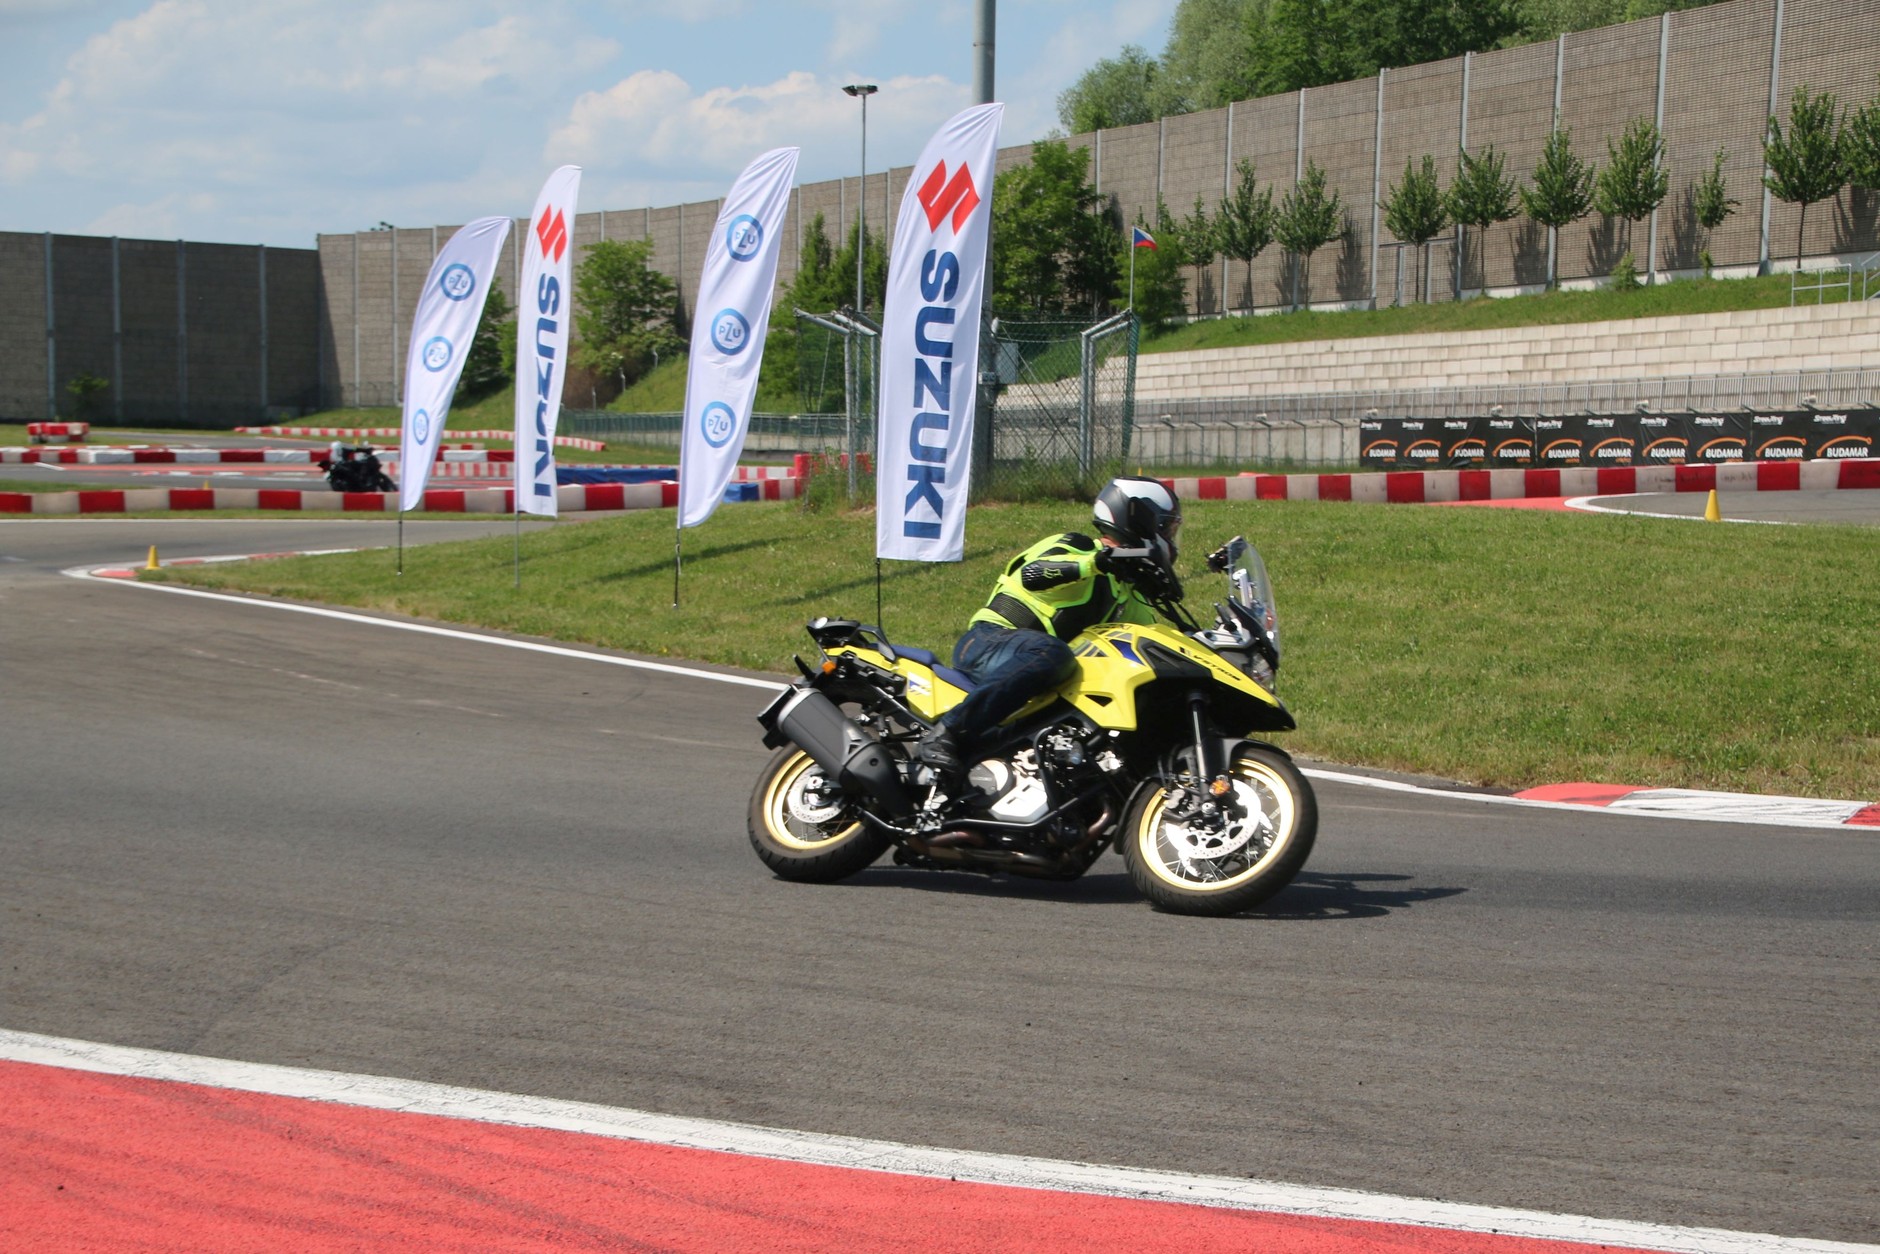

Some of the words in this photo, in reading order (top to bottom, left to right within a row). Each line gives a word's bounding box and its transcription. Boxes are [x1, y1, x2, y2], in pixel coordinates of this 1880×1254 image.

[735, 226, 755, 248] PZU
[448, 275, 467, 291] PZU
[719, 322, 741, 342] PZU
[429, 345, 447, 362] PZU
[904, 248, 959, 539] SUZUKI
[708, 414, 728, 434] PZU
[1369, 448, 1396, 457] BUDAMAR
[1411, 448, 1439, 457] BUDAMAR
[1500, 448, 1530, 458] BUDAMAR
[1548, 448, 1580, 458] BUDAMAR
[1598, 448, 1632, 458] BUDAMAR
[1651, 448, 1685, 458] BUDAMAR
[1706, 448, 1743, 458] BUDAMAR
[1765, 448, 1803, 458] BUDAMAR
[1826, 447, 1868, 458] BUDAMAR
